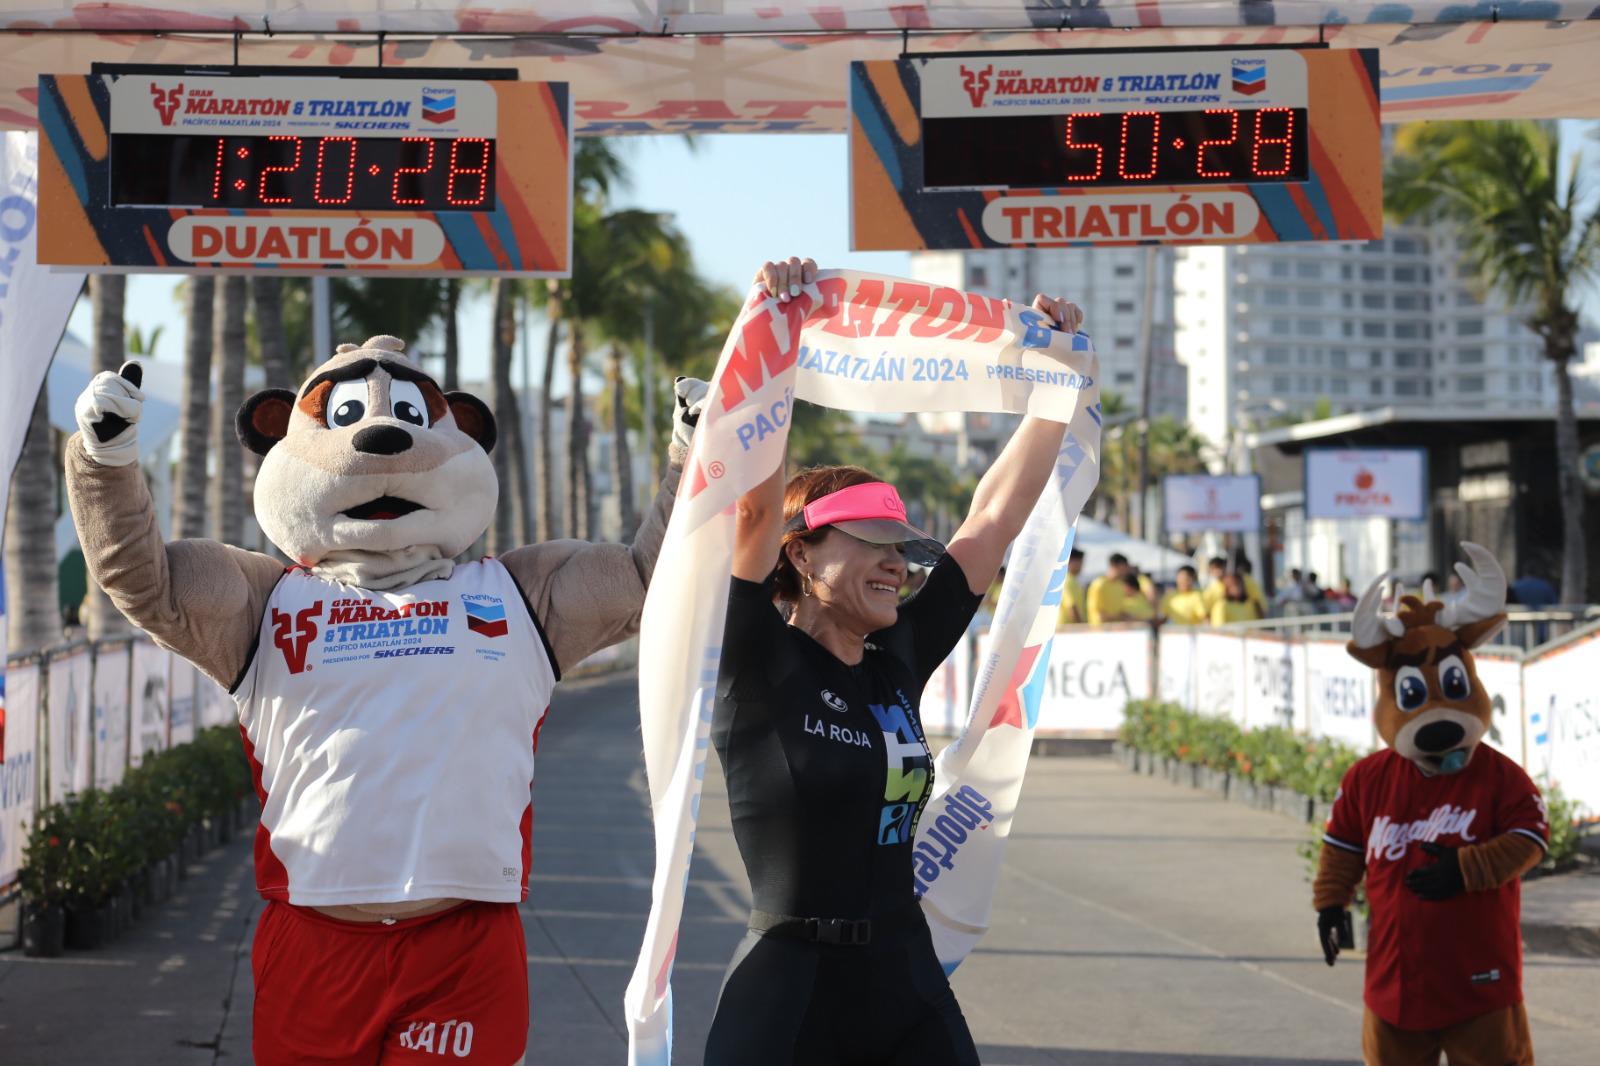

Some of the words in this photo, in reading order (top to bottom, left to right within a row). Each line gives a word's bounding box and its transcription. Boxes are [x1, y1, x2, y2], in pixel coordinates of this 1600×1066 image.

[1232, 58, 1266, 66] Chevron
[422, 87, 456, 95] Chevron
[994, 76, 1100, 95] MARATÓN
[1102, 78, 1113, 92] &
[1118, 73, 1221, 92] TRIATLÓN
[185, 98, 290, 115] MARATÓN
[293, 101, 304, 115] &
[308, 100, 411, 117] TRIATLÓN
[1144, 95, 1221, 104] SKECHERS
[335, 121, 410, 130] SKECHERS
[1002, 195, 1235, 239] TRIATLÓN
[192, 219, 413, 259] DUATLÓN
[912, 357, 970, 382] 2024
[328, 601, 449, 624] MARATÓN
[332, 599, 372, 607] GRAN
[324, 630, 335, 642] &
[337, 617, 449, 642] TRIATLÓN
[323, 643, 358, 653] PACÍFICO
[360, 638, 401, 649] MAZATLÁN
[403, 637, 422, 645] 2024
[373, 646, 456, 659] SKECHERS
[803, 714, 825, 737] LA
[829, 723, 872, 749] ROJA
[399, 1019, 474, 1057] KATO
